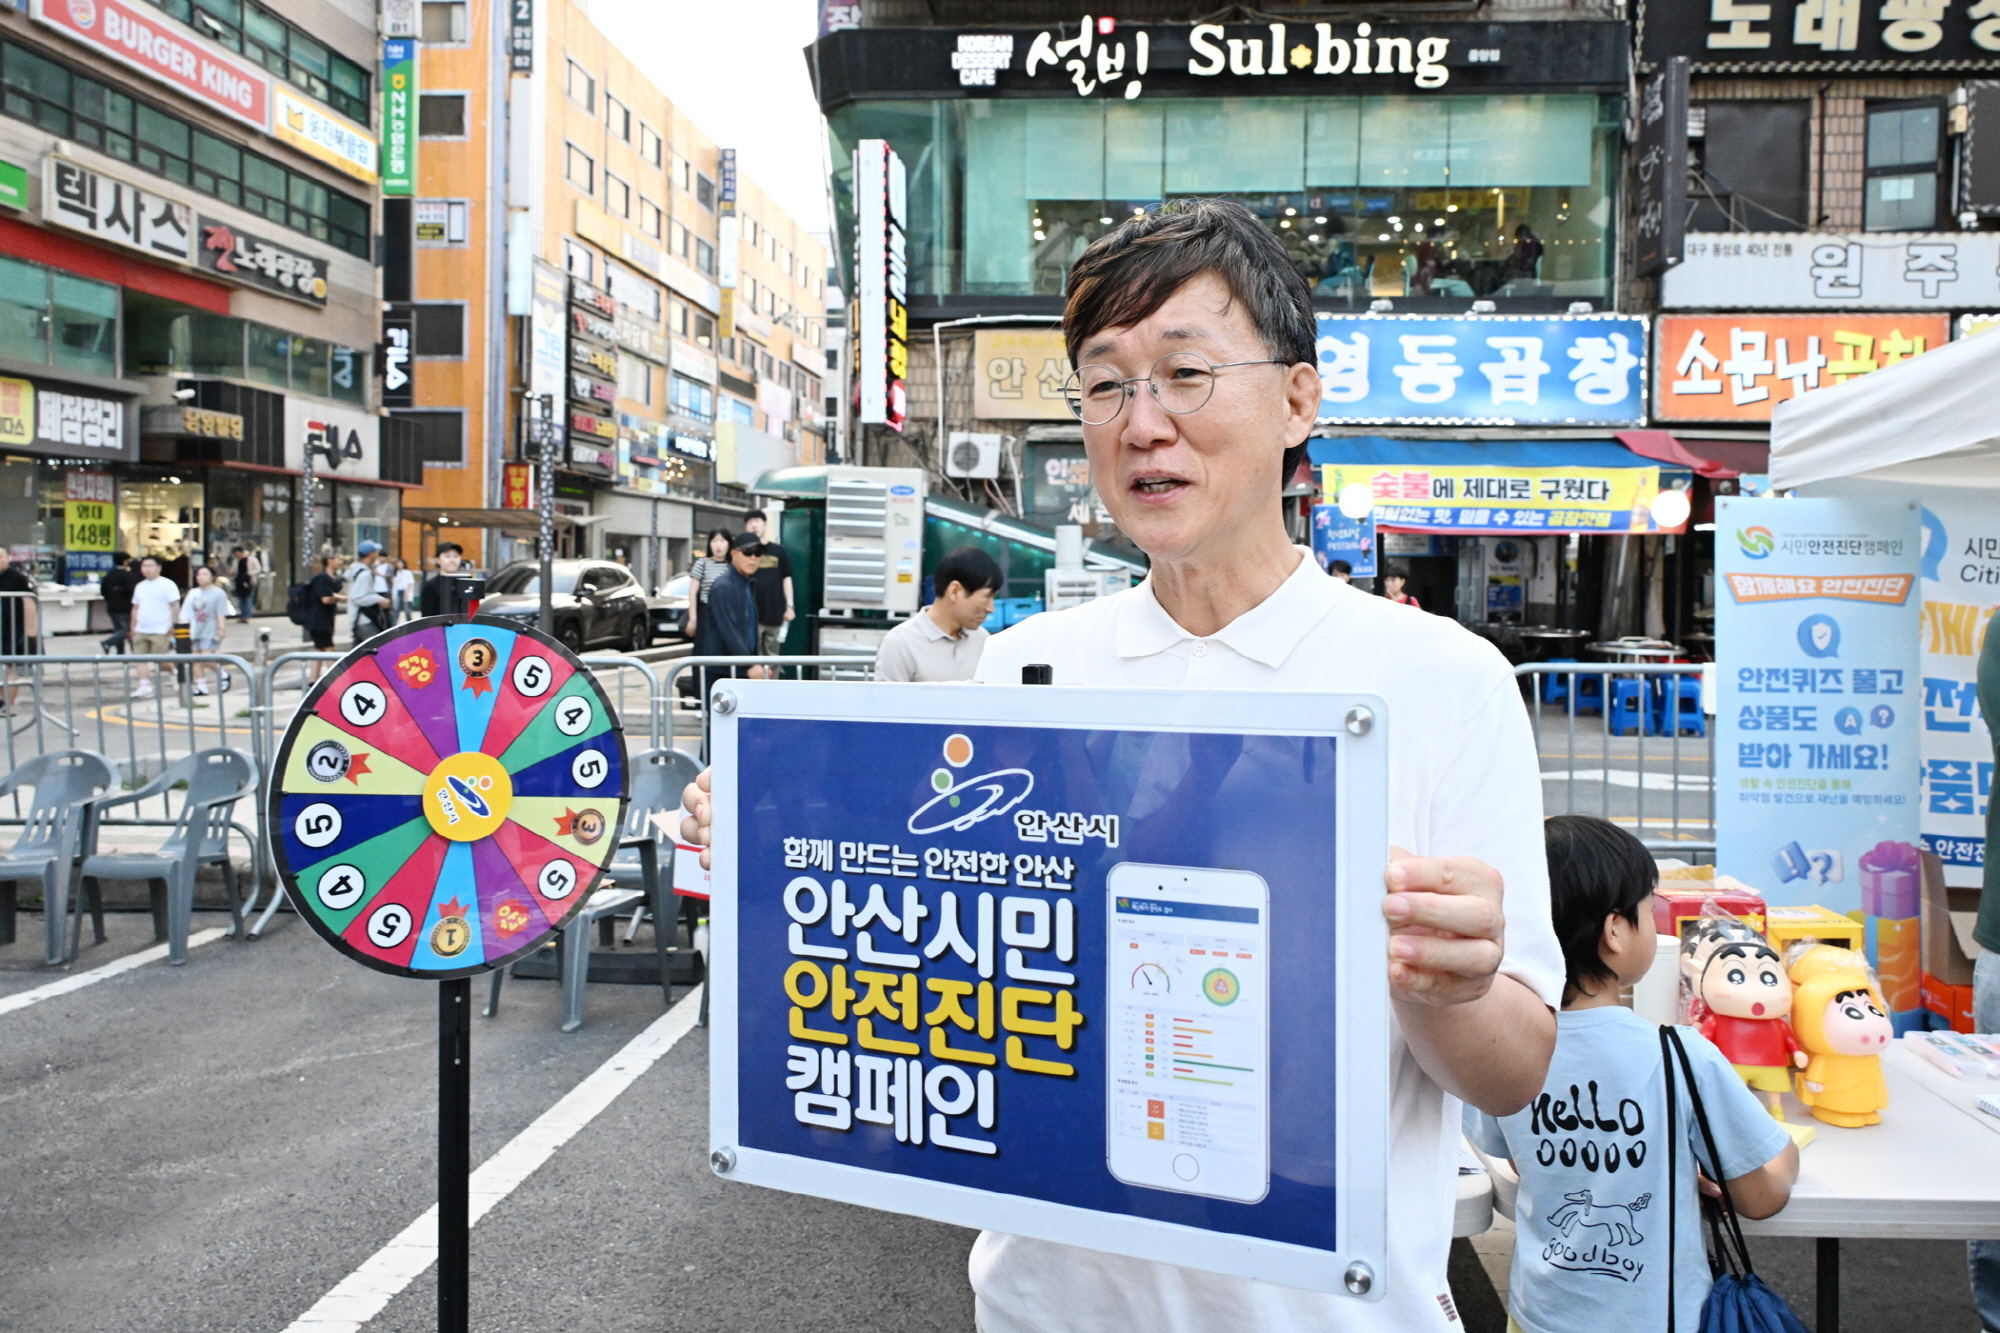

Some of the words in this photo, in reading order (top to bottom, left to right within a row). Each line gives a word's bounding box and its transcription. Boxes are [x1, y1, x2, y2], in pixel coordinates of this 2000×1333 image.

[957, 35, 1014, 52] KOREAN
[104, 6, 198, 82] BURGER
[201, 58, 253, 109] KING
[951, 52, 1013, 70] DESSERT
[1026, 14, 1150, 100] 설빙
[959, 69, 996, 86] CAFE
[56, 162, 189, 259] 텍사스
[1810, 242, 2000, 298] 원주
[386, 327, 409, 391] FILA
[1315, 331, 1639, 406] 영동곱창
[307, 420, 363, 461] FILA
[1371, 471, 1454, 499] 숯불에
[1463, 478, 1532, 500] 제대로
[1540, 478, 1610, 501] 구웠다
[1492, 511, 1510, 526] 수
[1512, 510, 1545, 527] 있는
[1731, 574, 1818, 597] 함께해요
[1820, 574, 1906, 598] 안전진단
[472, 649, 484, 667] 3
[523, 664, 544, 689] 5
[1738, 667, 1844, 694] 안전퀴즈
[354, 693, 377, 717] 4
[563, 705, 584, 727] 4
[1738, 705, 1817, 731] 상품도
[318, 755, 338, 770] 2
[578, 759, 600, 779] 5
[1738, 743, 1792, 769] 받아
[1799, 743, 1889, 771] 가세요!
[304, 813, 334, 835] 5
[581, 819, 597, 834] 3
[1015, 809, 1119, 848] 안산시
[783, 836, 834, 872] 함께
[839, 841, 920, 878] 만드는
[924, 846, 1010, 886] 안전한
[1014, 853, 1075, 891] 안산
[327, 874, 355, 899] 4
[546, 869, 569, 892] 5
[376, 912, 401, 938] 5
[445, 928, 457, 946] 1
[783, 875, 1075, 986] 안산시민
[783, 959, 1084, 1077] 안전진단
[785, 1044, 998, 1155] 캠페인
